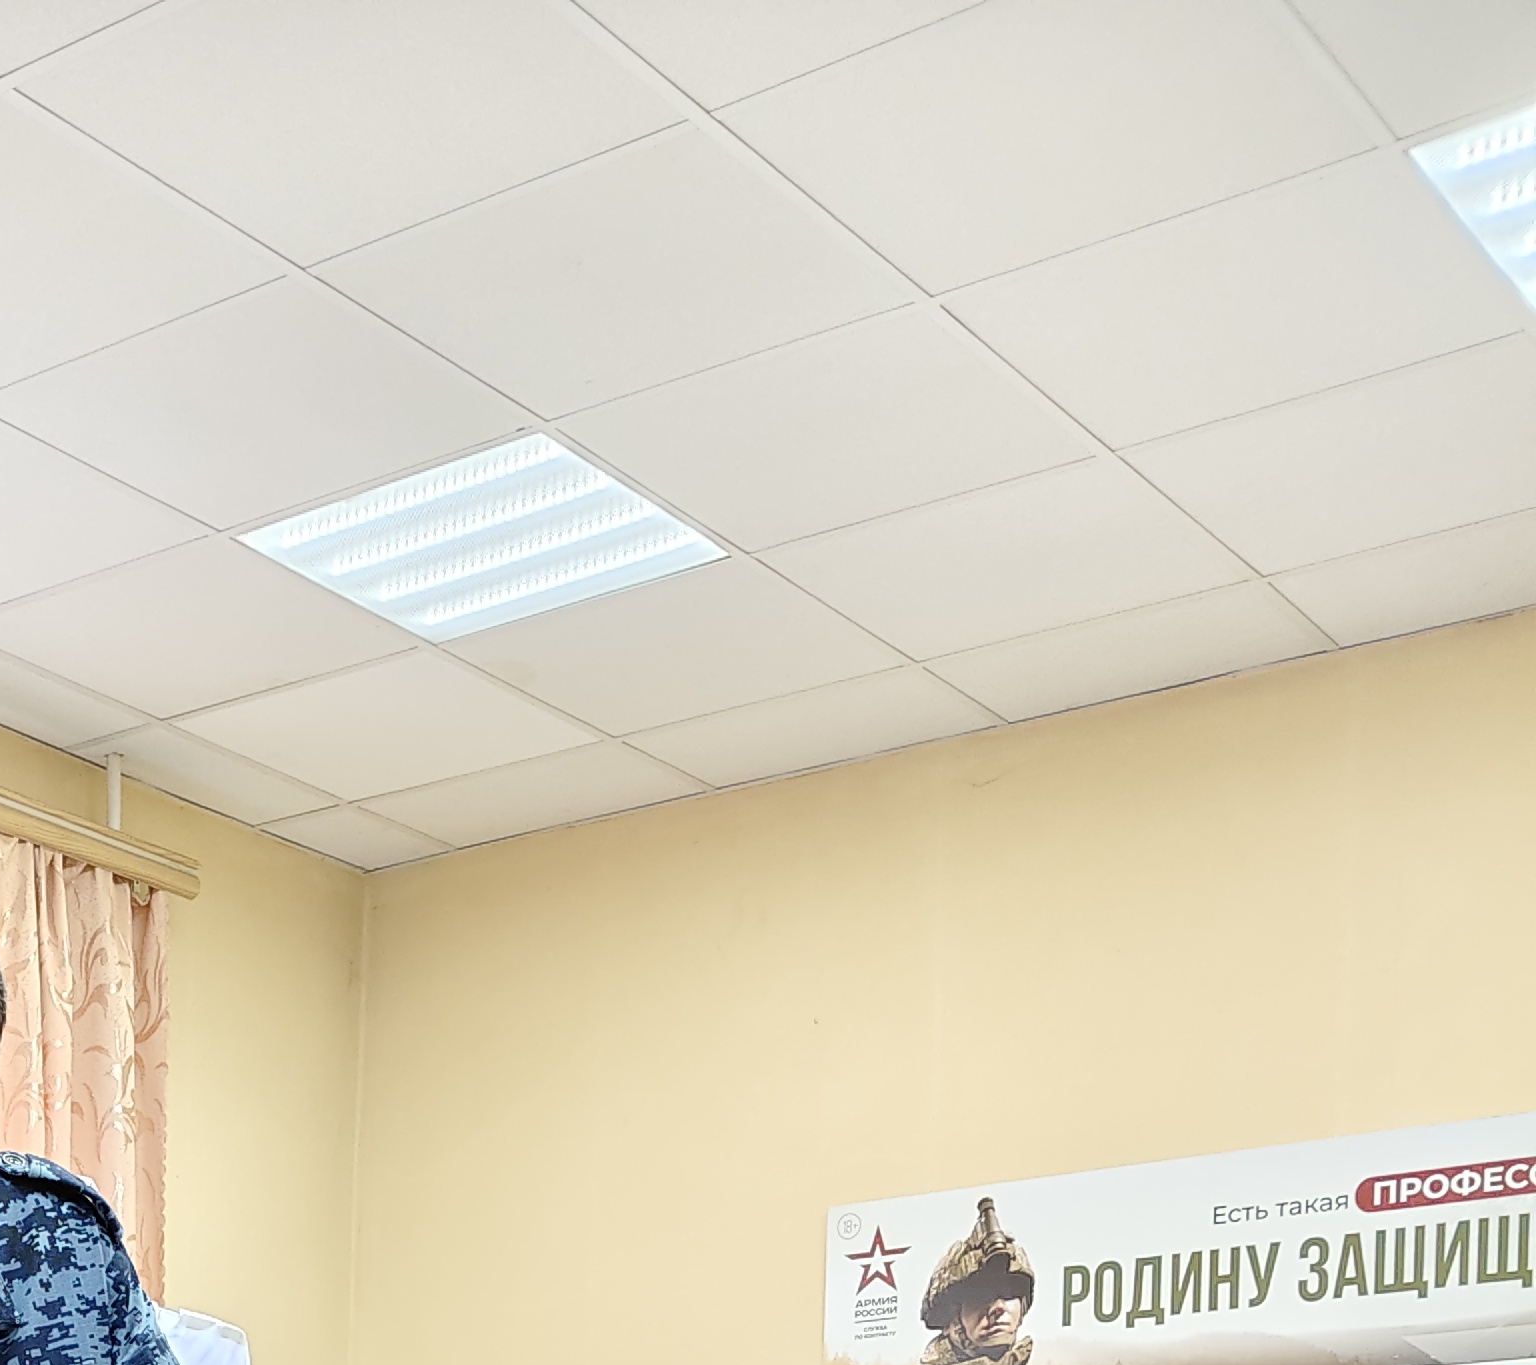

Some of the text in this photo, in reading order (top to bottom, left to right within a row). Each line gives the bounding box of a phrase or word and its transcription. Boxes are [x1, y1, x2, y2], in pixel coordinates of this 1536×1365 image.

[1213, 1206, 1268, 1225] Есть
[1275, 1194, 1349, 1217] такая
[843, 1219, 859, 1234] 18+
[1062, 1241, 1281, 1328] РОДИНУ
[855, 1296, 898, 1308] АРМИЯ
[854, 1306, 898, 1318] РОССИИ
